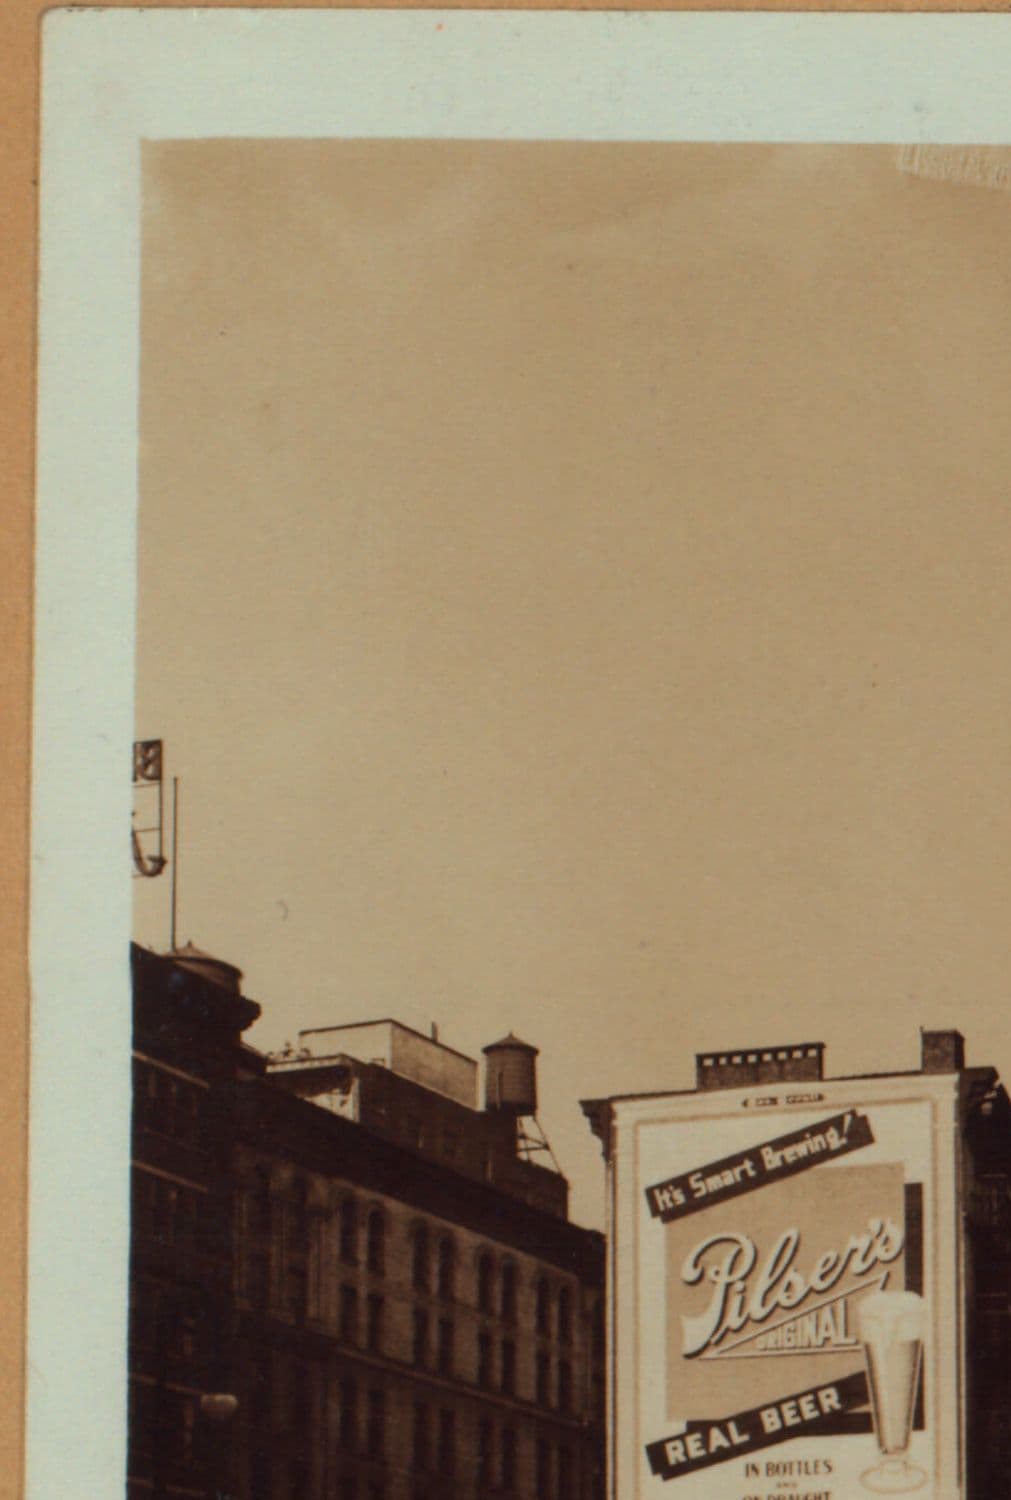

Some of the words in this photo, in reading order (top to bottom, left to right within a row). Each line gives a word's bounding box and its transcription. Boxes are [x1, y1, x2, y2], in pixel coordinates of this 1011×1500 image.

[653, 1184, 686, 1211] It's
[688, 1159, 756, 1198] Smart
[760, 1114, 852, 1171] Brewing!
[757, 1298, 859, 1350] ORIGINAL
[664, 1421, 750, 1466] REAL
[759, 1386, 842, 1434] BEER
[745, 1463, 760, 1478] IN
[766, 1459, 833, 1477] BOTTLES
